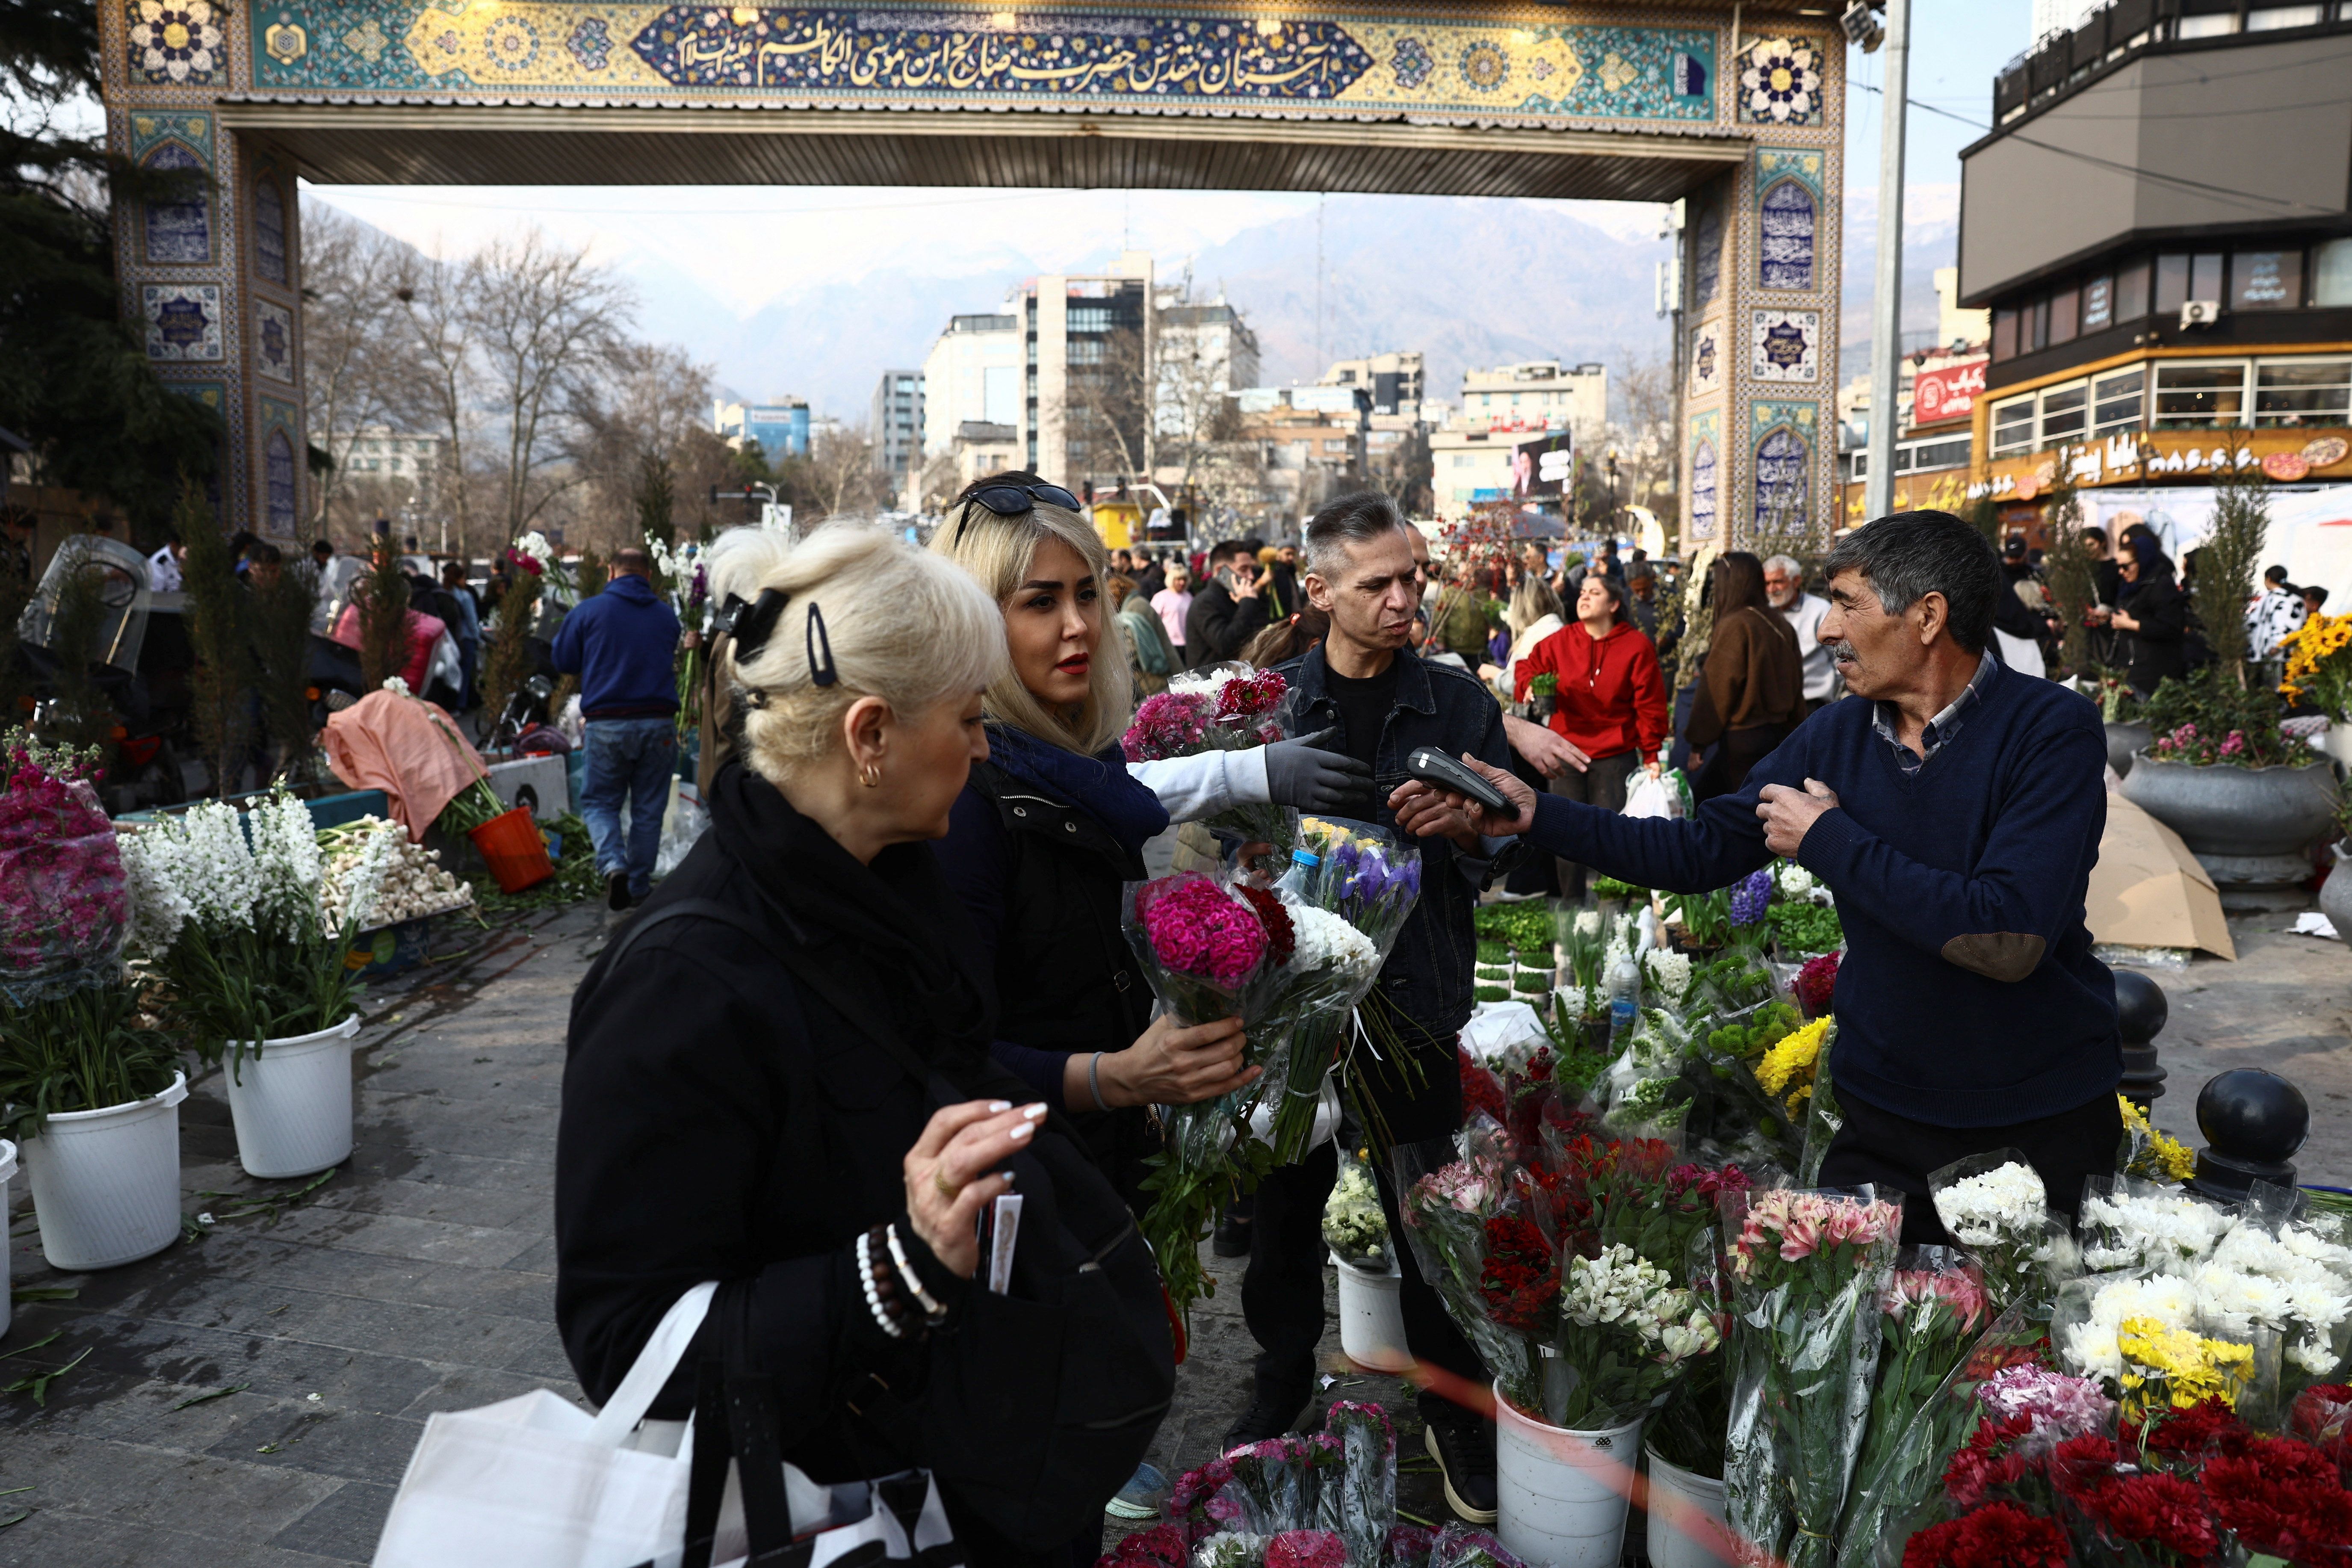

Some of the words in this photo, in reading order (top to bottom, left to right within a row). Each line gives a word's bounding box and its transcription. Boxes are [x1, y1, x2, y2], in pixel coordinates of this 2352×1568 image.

[757, 18, 852, 88] الکاظم
[903, 38, 950, 87] ابن
[948, 32, 1012, 89] صالح
[1011, 44, 1137, 93] حضرت
[1129, 44, 1201, 93] مقدس
[1199, 42, 1330, 94] آستان
[2106, 431, 2138, 476] بابا
